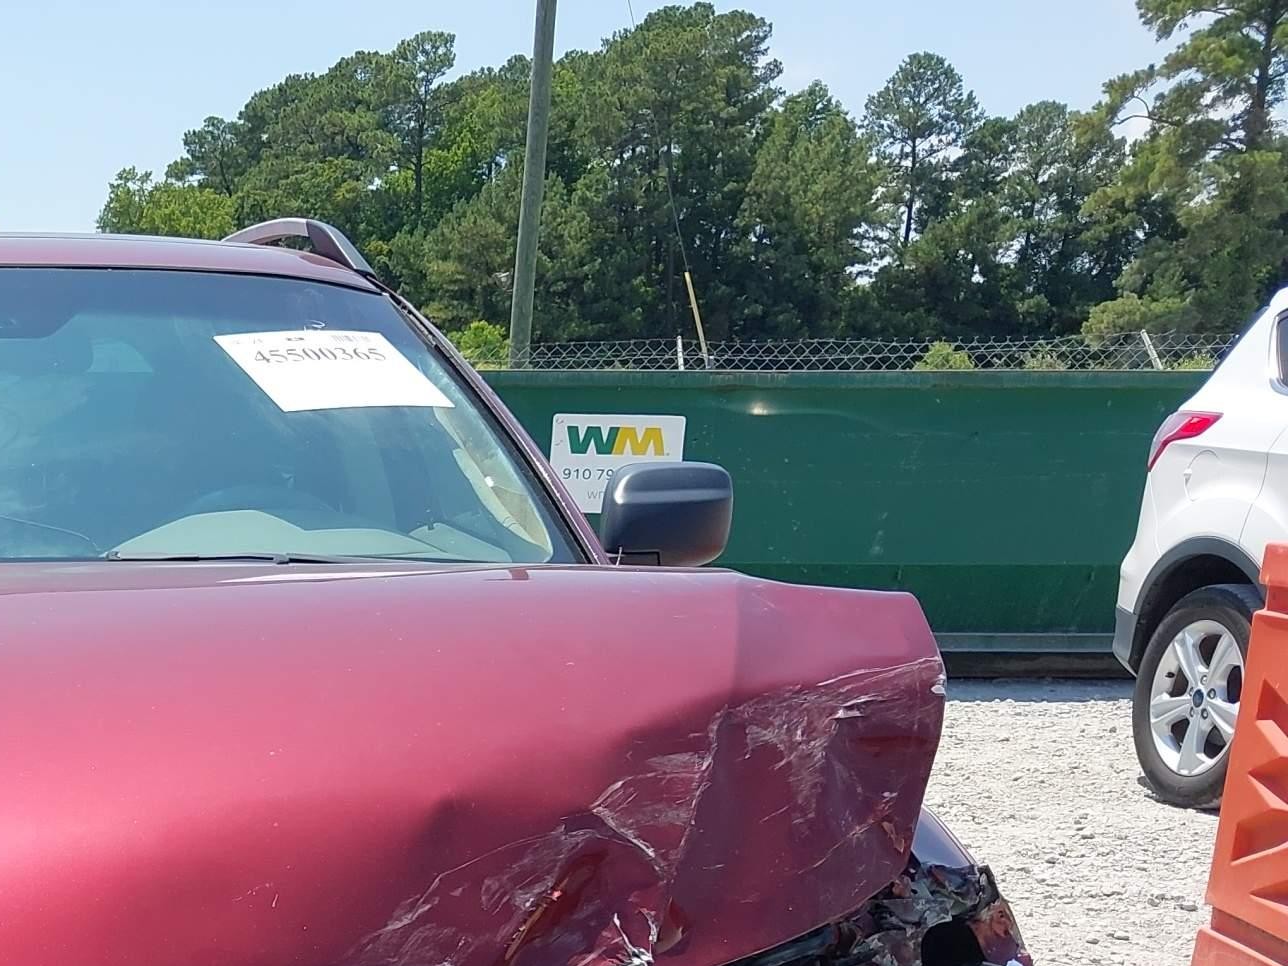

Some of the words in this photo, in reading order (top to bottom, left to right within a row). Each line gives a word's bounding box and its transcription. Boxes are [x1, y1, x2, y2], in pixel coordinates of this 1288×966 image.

[254, 346, 387, 364] 45500365
[566, 425, 665, 456] WM
[562, 468, 592, 481] 910
[597, 468, 614, 481] 79
